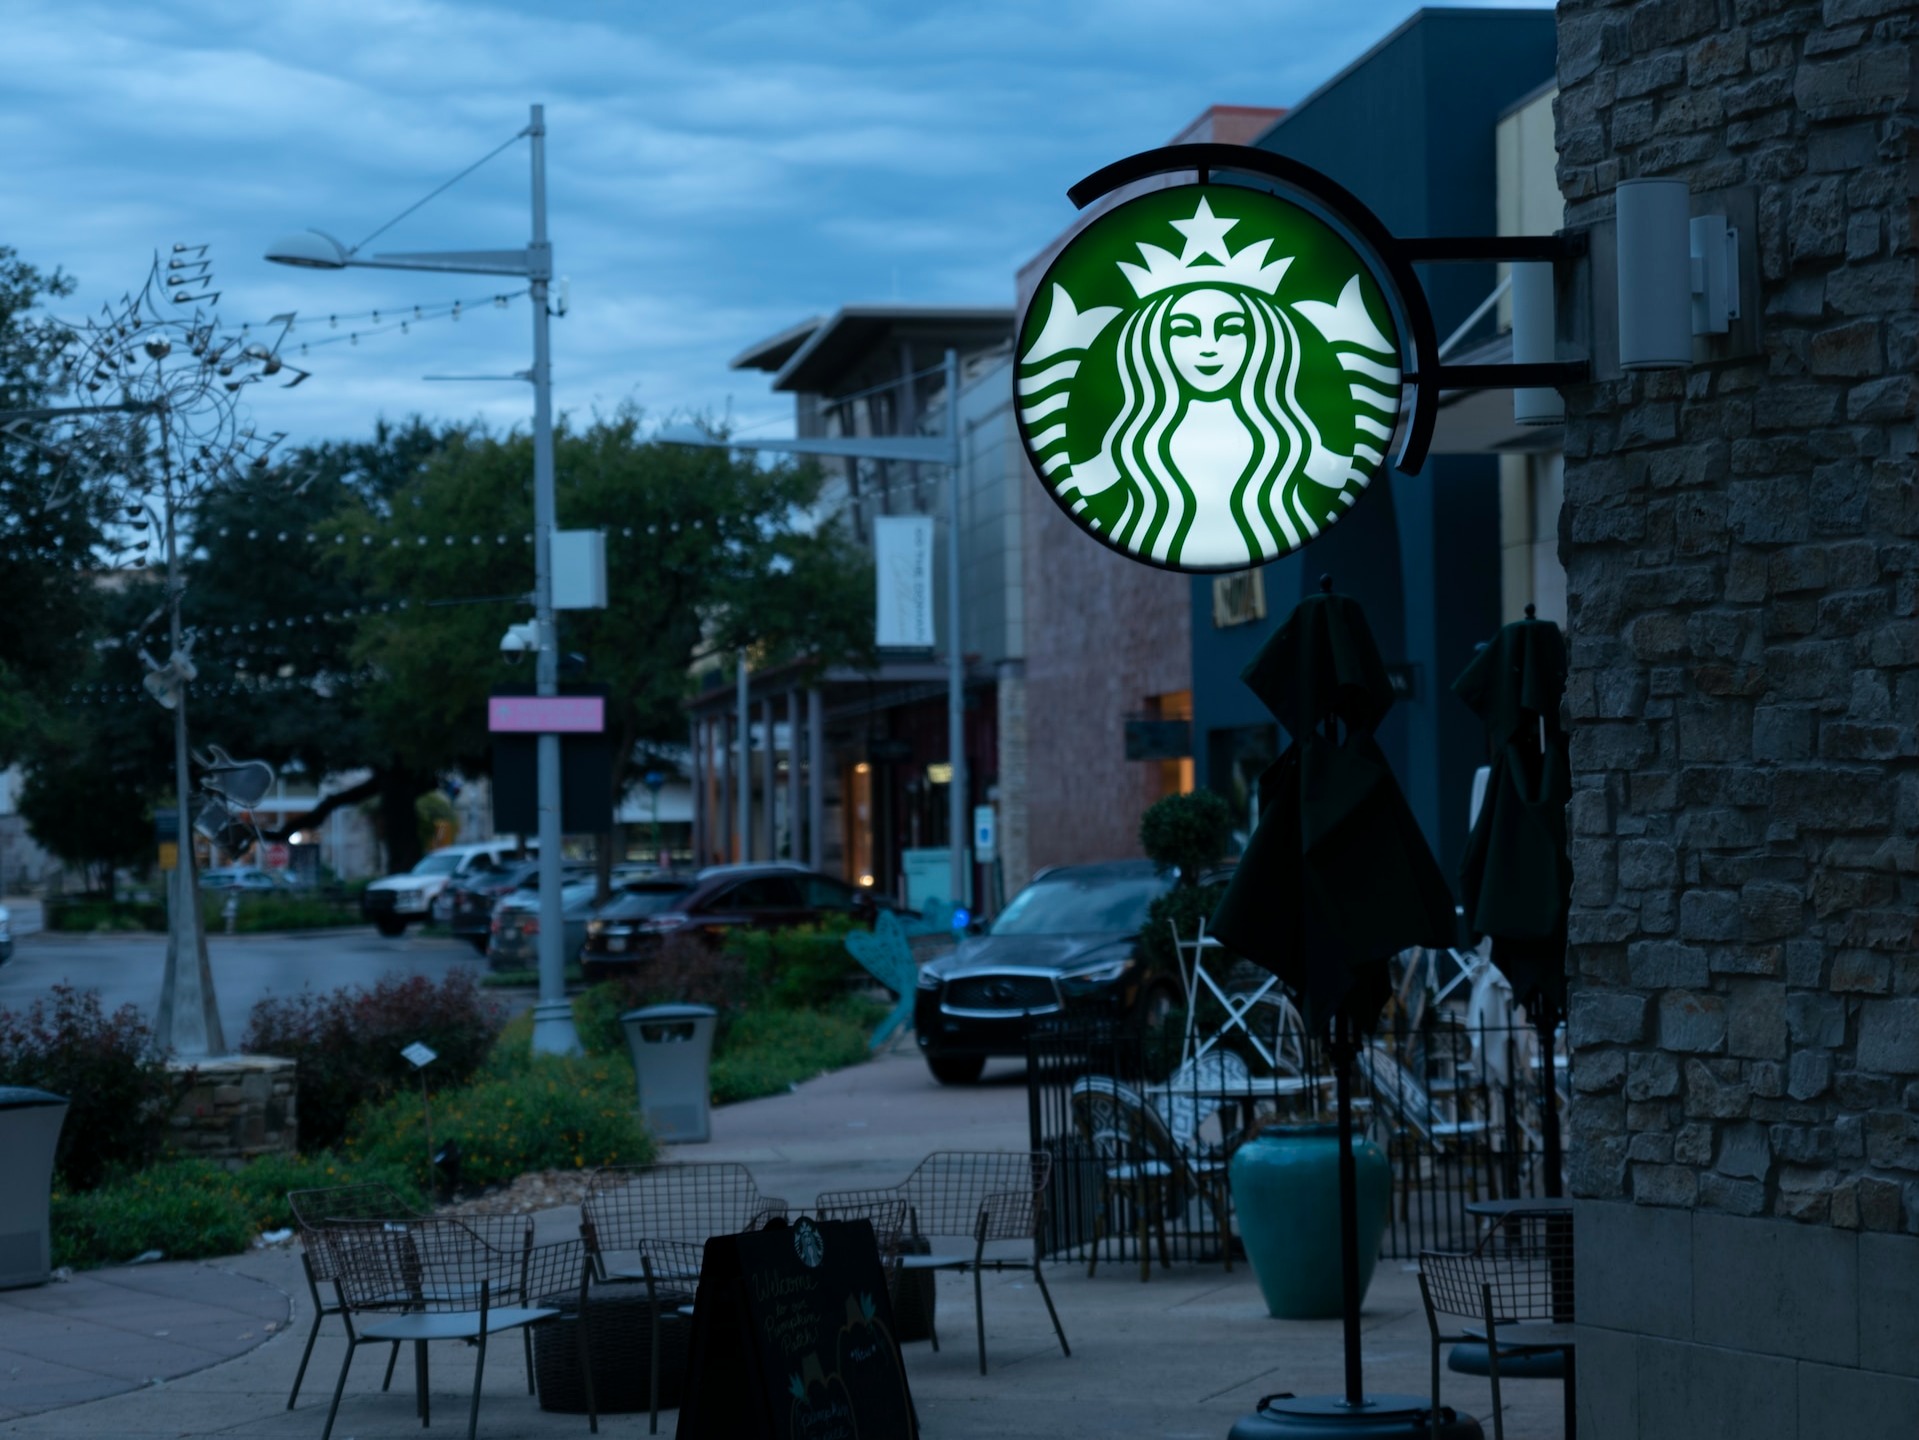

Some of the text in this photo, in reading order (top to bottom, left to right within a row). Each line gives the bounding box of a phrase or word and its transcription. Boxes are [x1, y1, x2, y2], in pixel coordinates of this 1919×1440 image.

[753, 1269, 818, 1302] Welcome
[776, 1301, 788, 1319] to
[764, 1312, 822, 1343] Pumpkin
